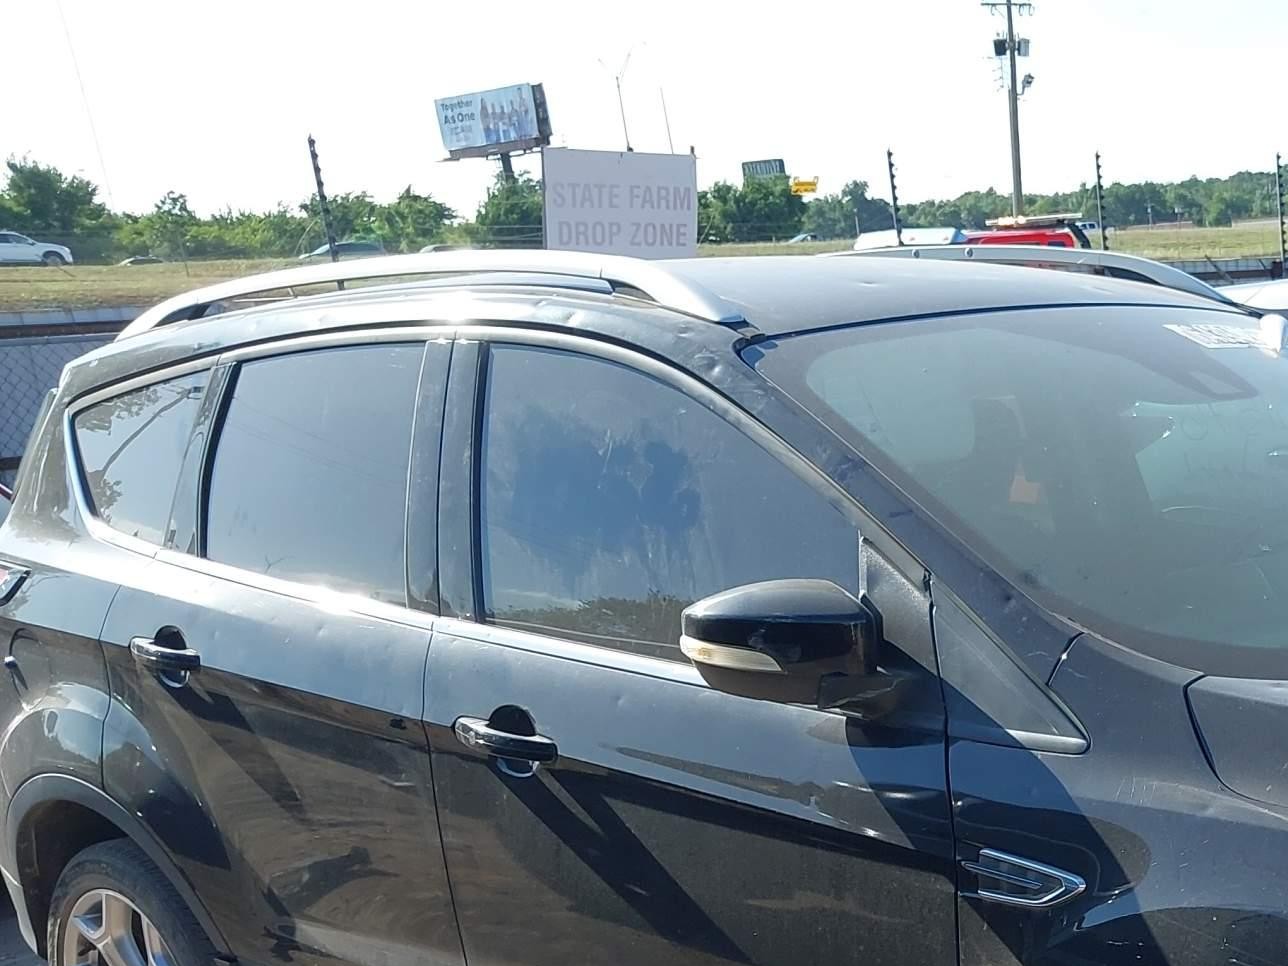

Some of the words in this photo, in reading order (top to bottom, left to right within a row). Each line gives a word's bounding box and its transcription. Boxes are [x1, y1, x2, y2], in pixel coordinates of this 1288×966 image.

[440, 99, 473, 113] Together
[444, 113, 456, 125] As
[456, 112, 476, 123] One
[552, 182, 621, 209] STATE
[629, 184, 692, 211] FARM
[558, 220, 621, 247] DROP
[629, 222, 688, 247] ZONE
